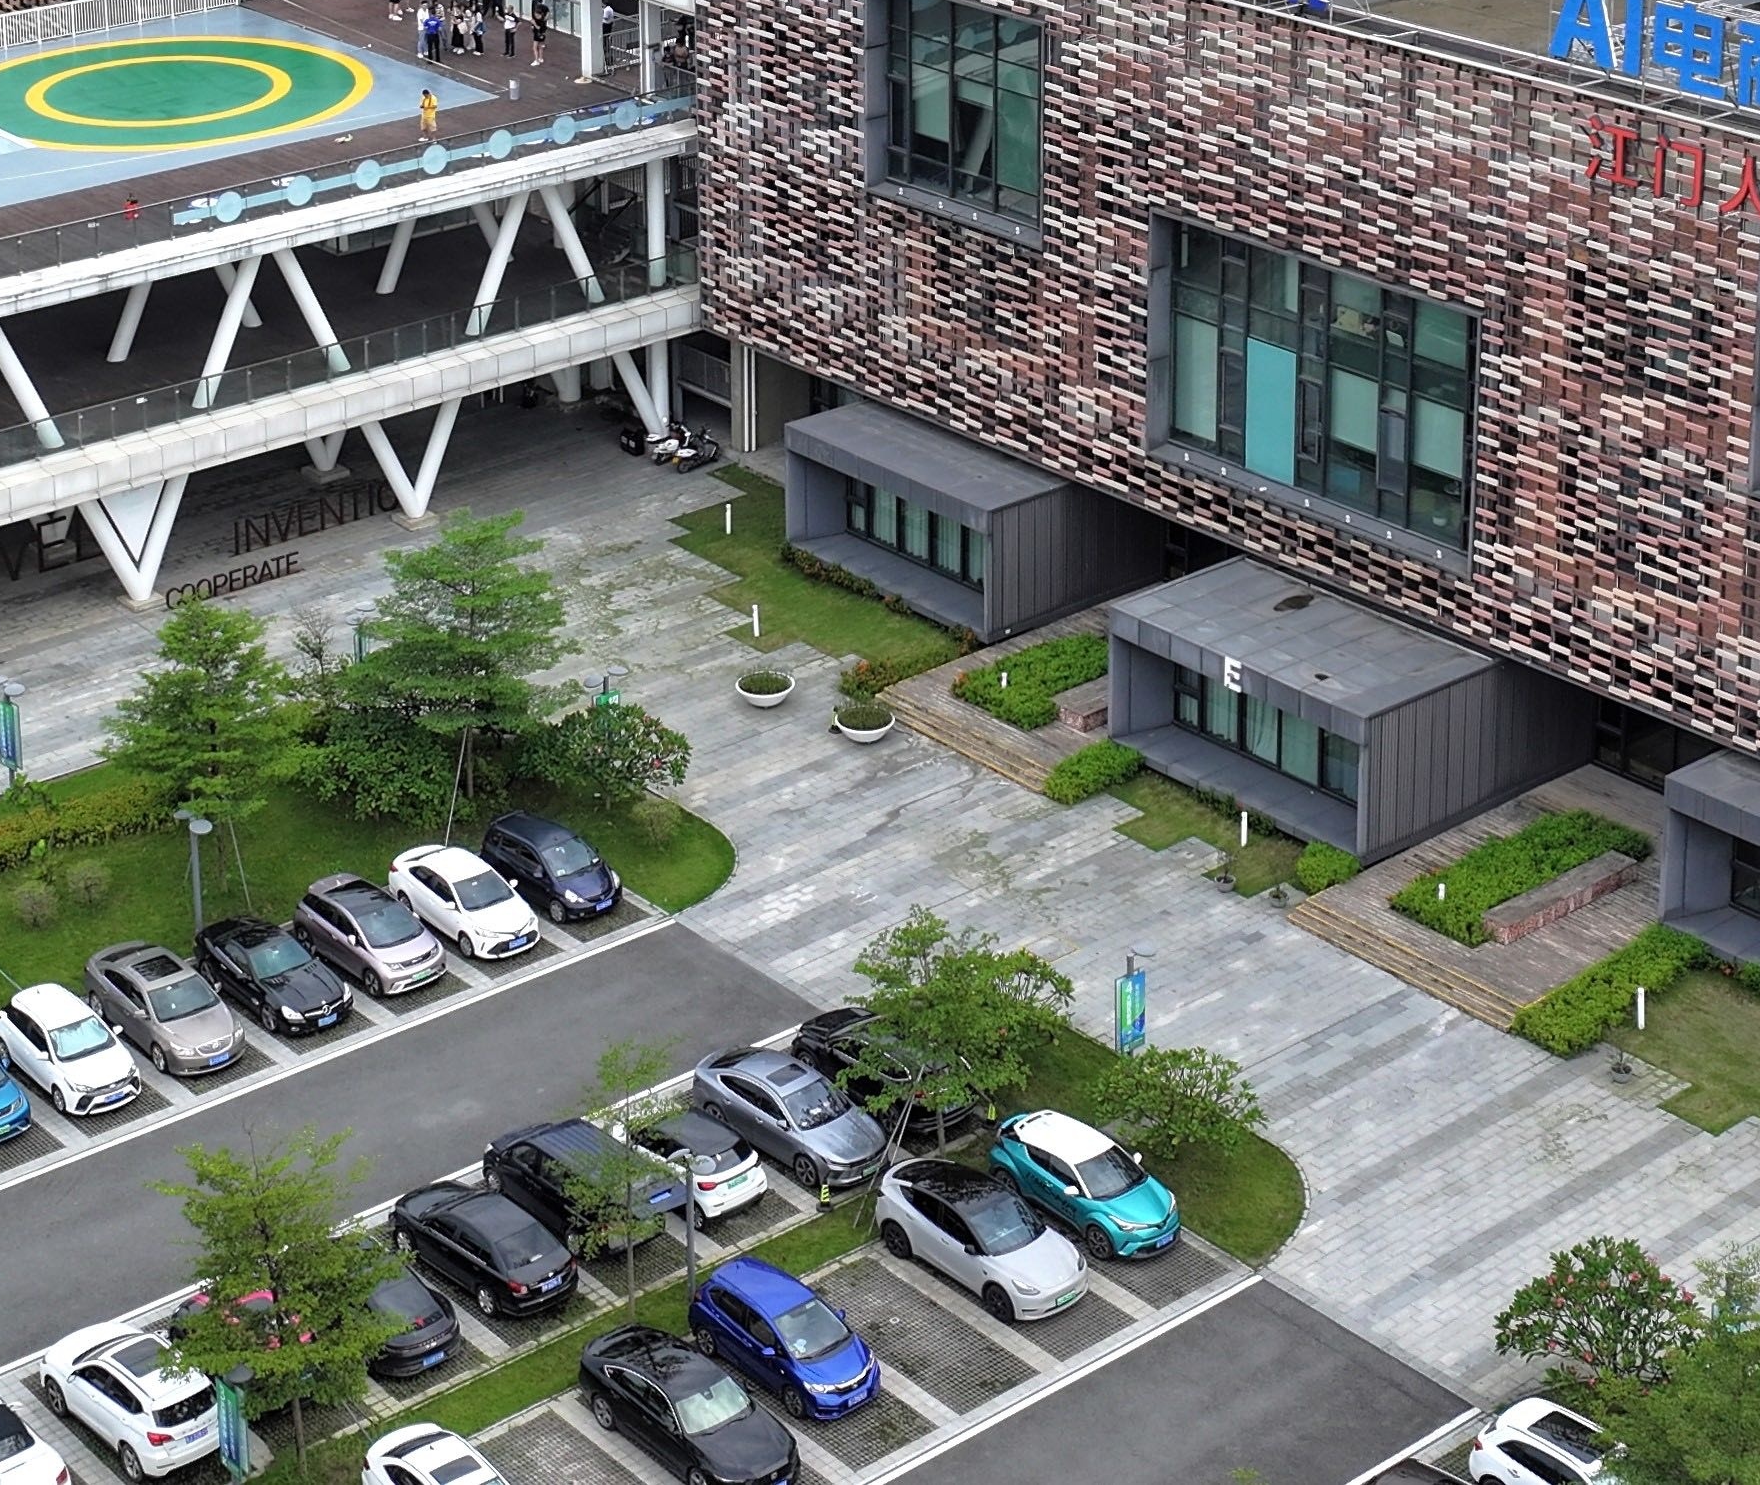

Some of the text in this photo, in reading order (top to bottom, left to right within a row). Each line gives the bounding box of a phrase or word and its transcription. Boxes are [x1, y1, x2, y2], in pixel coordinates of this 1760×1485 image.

[230, 476, 398, 556] INVENTIO
[166, 551, 299, 610] COOPERATE
[1224, 656, 1243, 694] E
